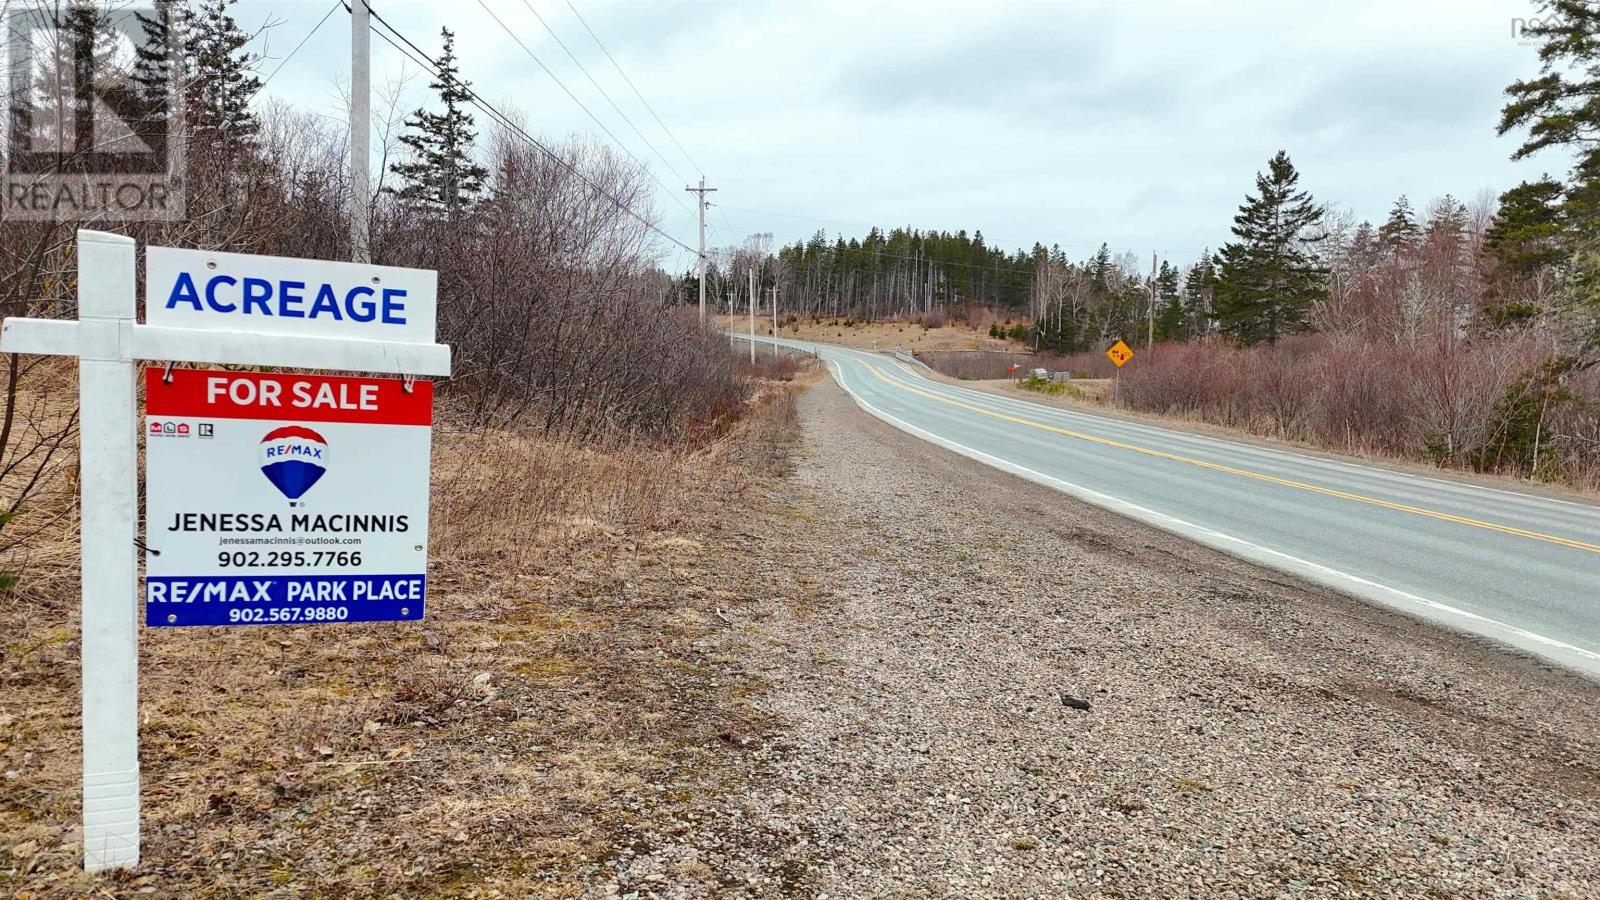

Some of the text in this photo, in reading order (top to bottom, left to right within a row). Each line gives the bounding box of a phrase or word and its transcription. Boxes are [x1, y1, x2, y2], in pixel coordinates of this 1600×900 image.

[165, 272, 407, 325] ACREAGE
[207, 377, 379, 411] FOR SALE
[266, 444, 322, 459] RE/MAX
[168, 513, 409, 532] JENESSA MACINNIS
[219, 536, 362, 546] jenessamacinnis@outlook.com
[218, 551, 362, 568] 902.295.7766
[147, 580, 421, 603] RE/MAX PARK PLACE
[229, 606, 348, 622] 902.567.9880
